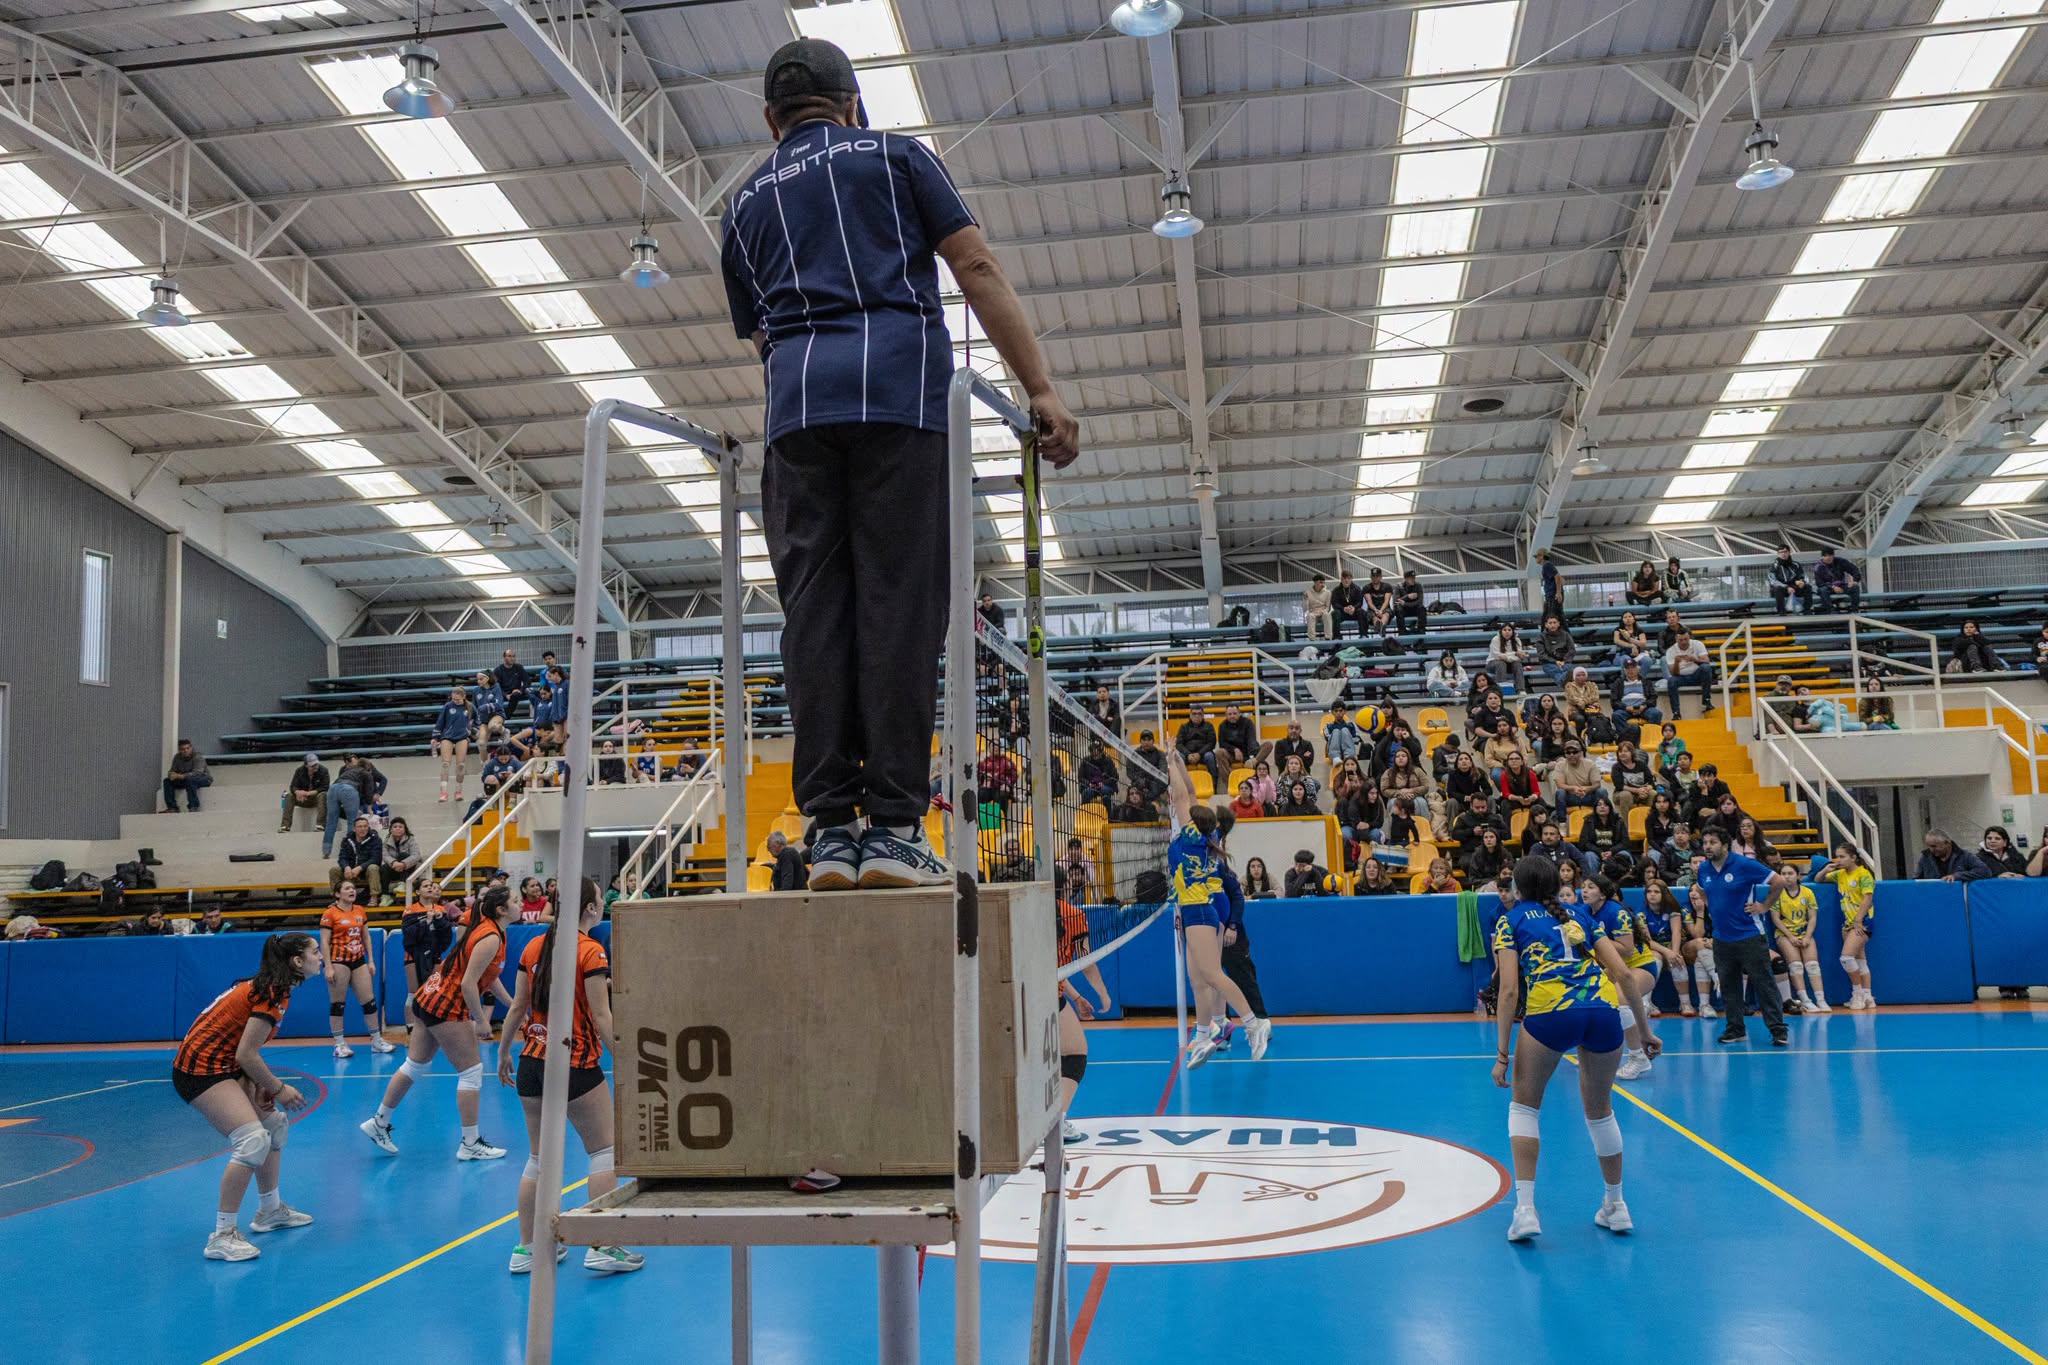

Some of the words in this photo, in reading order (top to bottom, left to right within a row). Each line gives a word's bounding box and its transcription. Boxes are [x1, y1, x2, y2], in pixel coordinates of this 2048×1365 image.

[737, 139, 879, 210] ARBITRO
[348, 926, 361, 937] 22
[1552, 924, 1581, 962] 1
[676, 1025, 733, 1150] 60
[638, 1103, 648, 1152] SPORT
